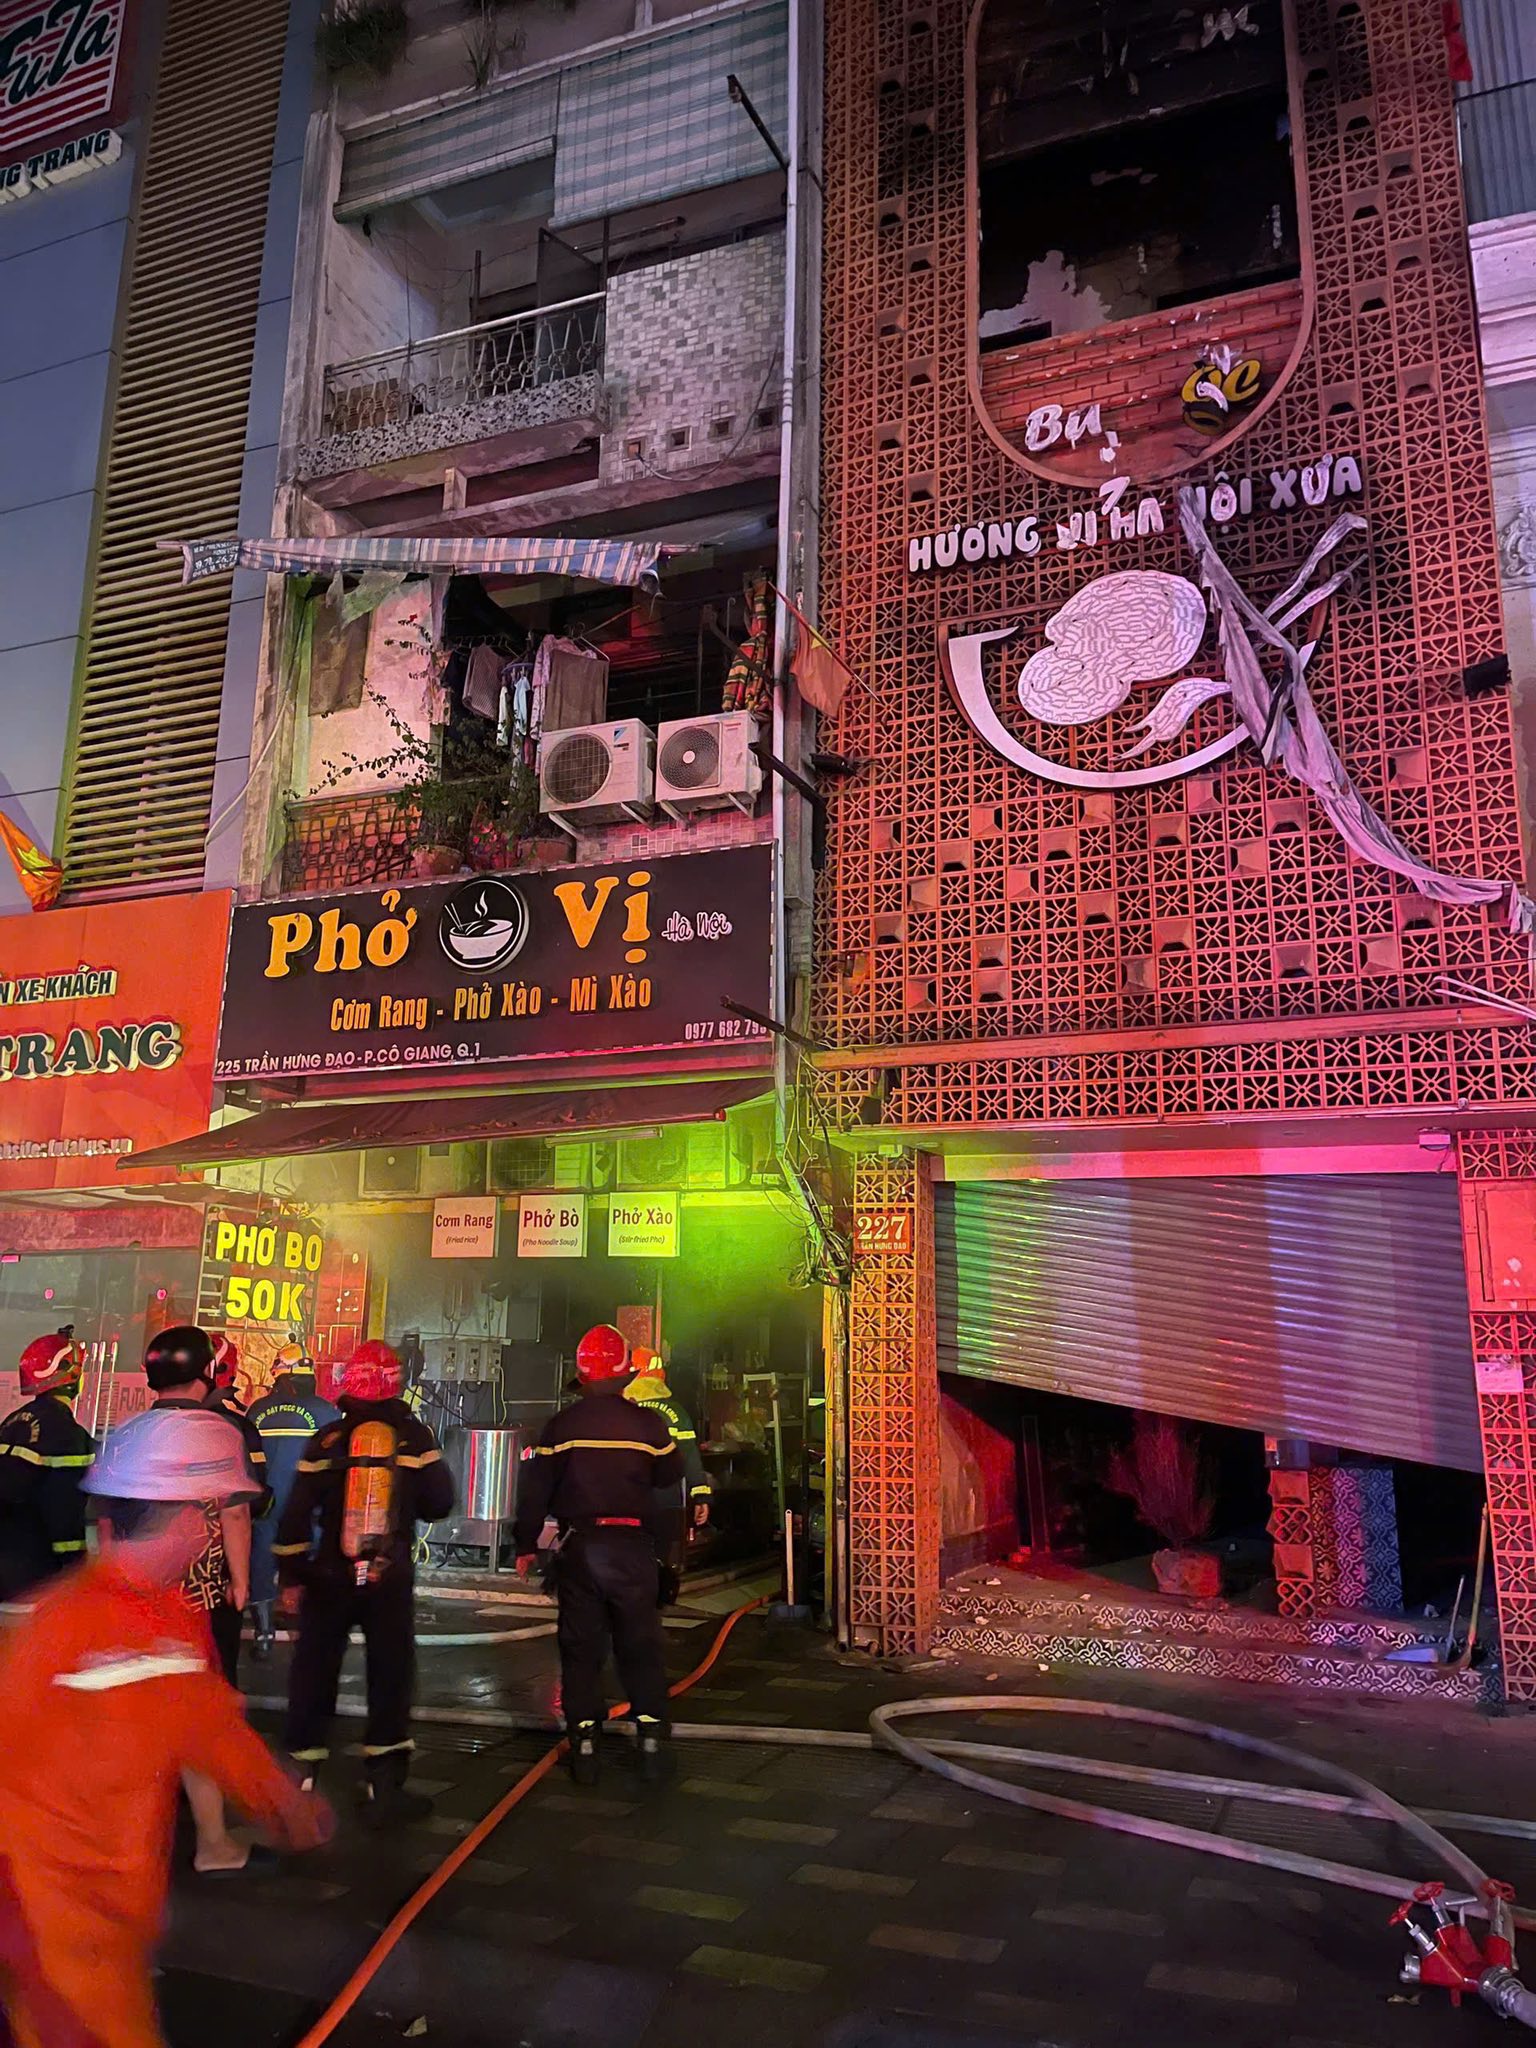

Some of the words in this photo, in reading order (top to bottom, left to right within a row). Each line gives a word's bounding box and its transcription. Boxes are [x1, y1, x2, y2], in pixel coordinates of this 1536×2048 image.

[28, 129, 111, 178] TRANG
[908, 515, 1041, 573] HƯƠNG
[1269, 452, 1363, 510] XƯA
[264, 889, 418, 978] Phở
[552, 870, 652, 964] Vị
[661, 911, 695, 942] Hà
[697, 911, 733, 941] Nội
[15, 978, 42, 1003] XE
[45, 965, 113, 1000] KHÁCH
[330, 997, 369, 1031] Cơm
[379, 995, 428, 1031] Rang
[454, 982, 493, 1022] Phở
[501, 979, 542, 1017] Xào
[570, 976, 598, 1012] Mì
[608, 972, 652, 1010] Xào
[685, 1022, 714, 1040] 0977
[718, 1020, 741, 1038] 682
[216, 1060, 241, 1075] 225
[245, 1050, 279, 1073] TRẦN
[282, 1053, 322, 1070] HƯNG
[404, 1044, 454, 1061] GIANG,
[457, 1043, 481, 1059] Q.1
[435, 1214, 461, 1228] Cơm
[463, 1213, 494, 1230] Rang
[523, 1208, 556, 1228] Phở
[560, 1208, 580, 1228] Bò
[613, 1207, 643, 1226] Phở
[646, 1206, 673, 1226] Xào
[857, 1215, 907, 1240] 227
[225, 1276, 306, 1321] 50K
